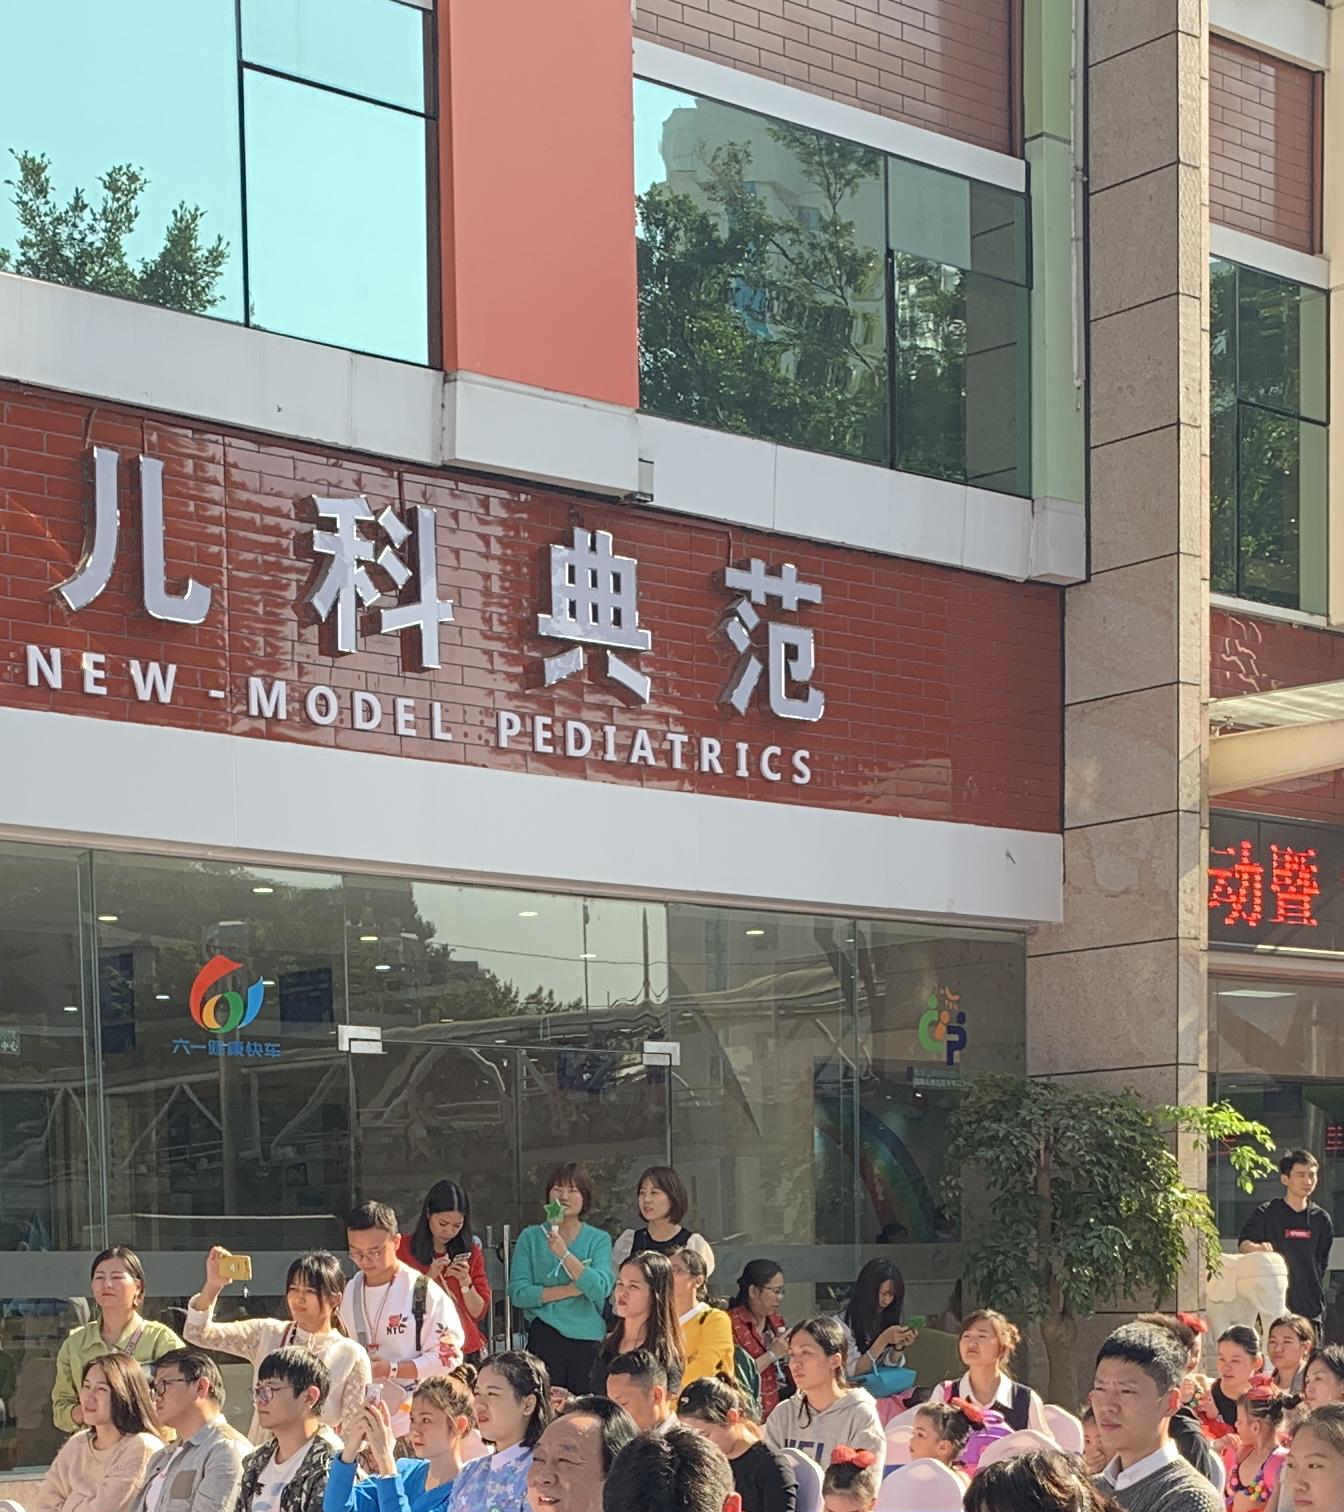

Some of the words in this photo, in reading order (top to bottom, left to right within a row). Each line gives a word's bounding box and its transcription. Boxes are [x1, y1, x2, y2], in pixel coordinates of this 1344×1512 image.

[497, 710, 812, 786] PEDIATRICS
[171, 1038, 281, 1057] 六一健康快车
[386, 1325, 406, 1335] NYC
